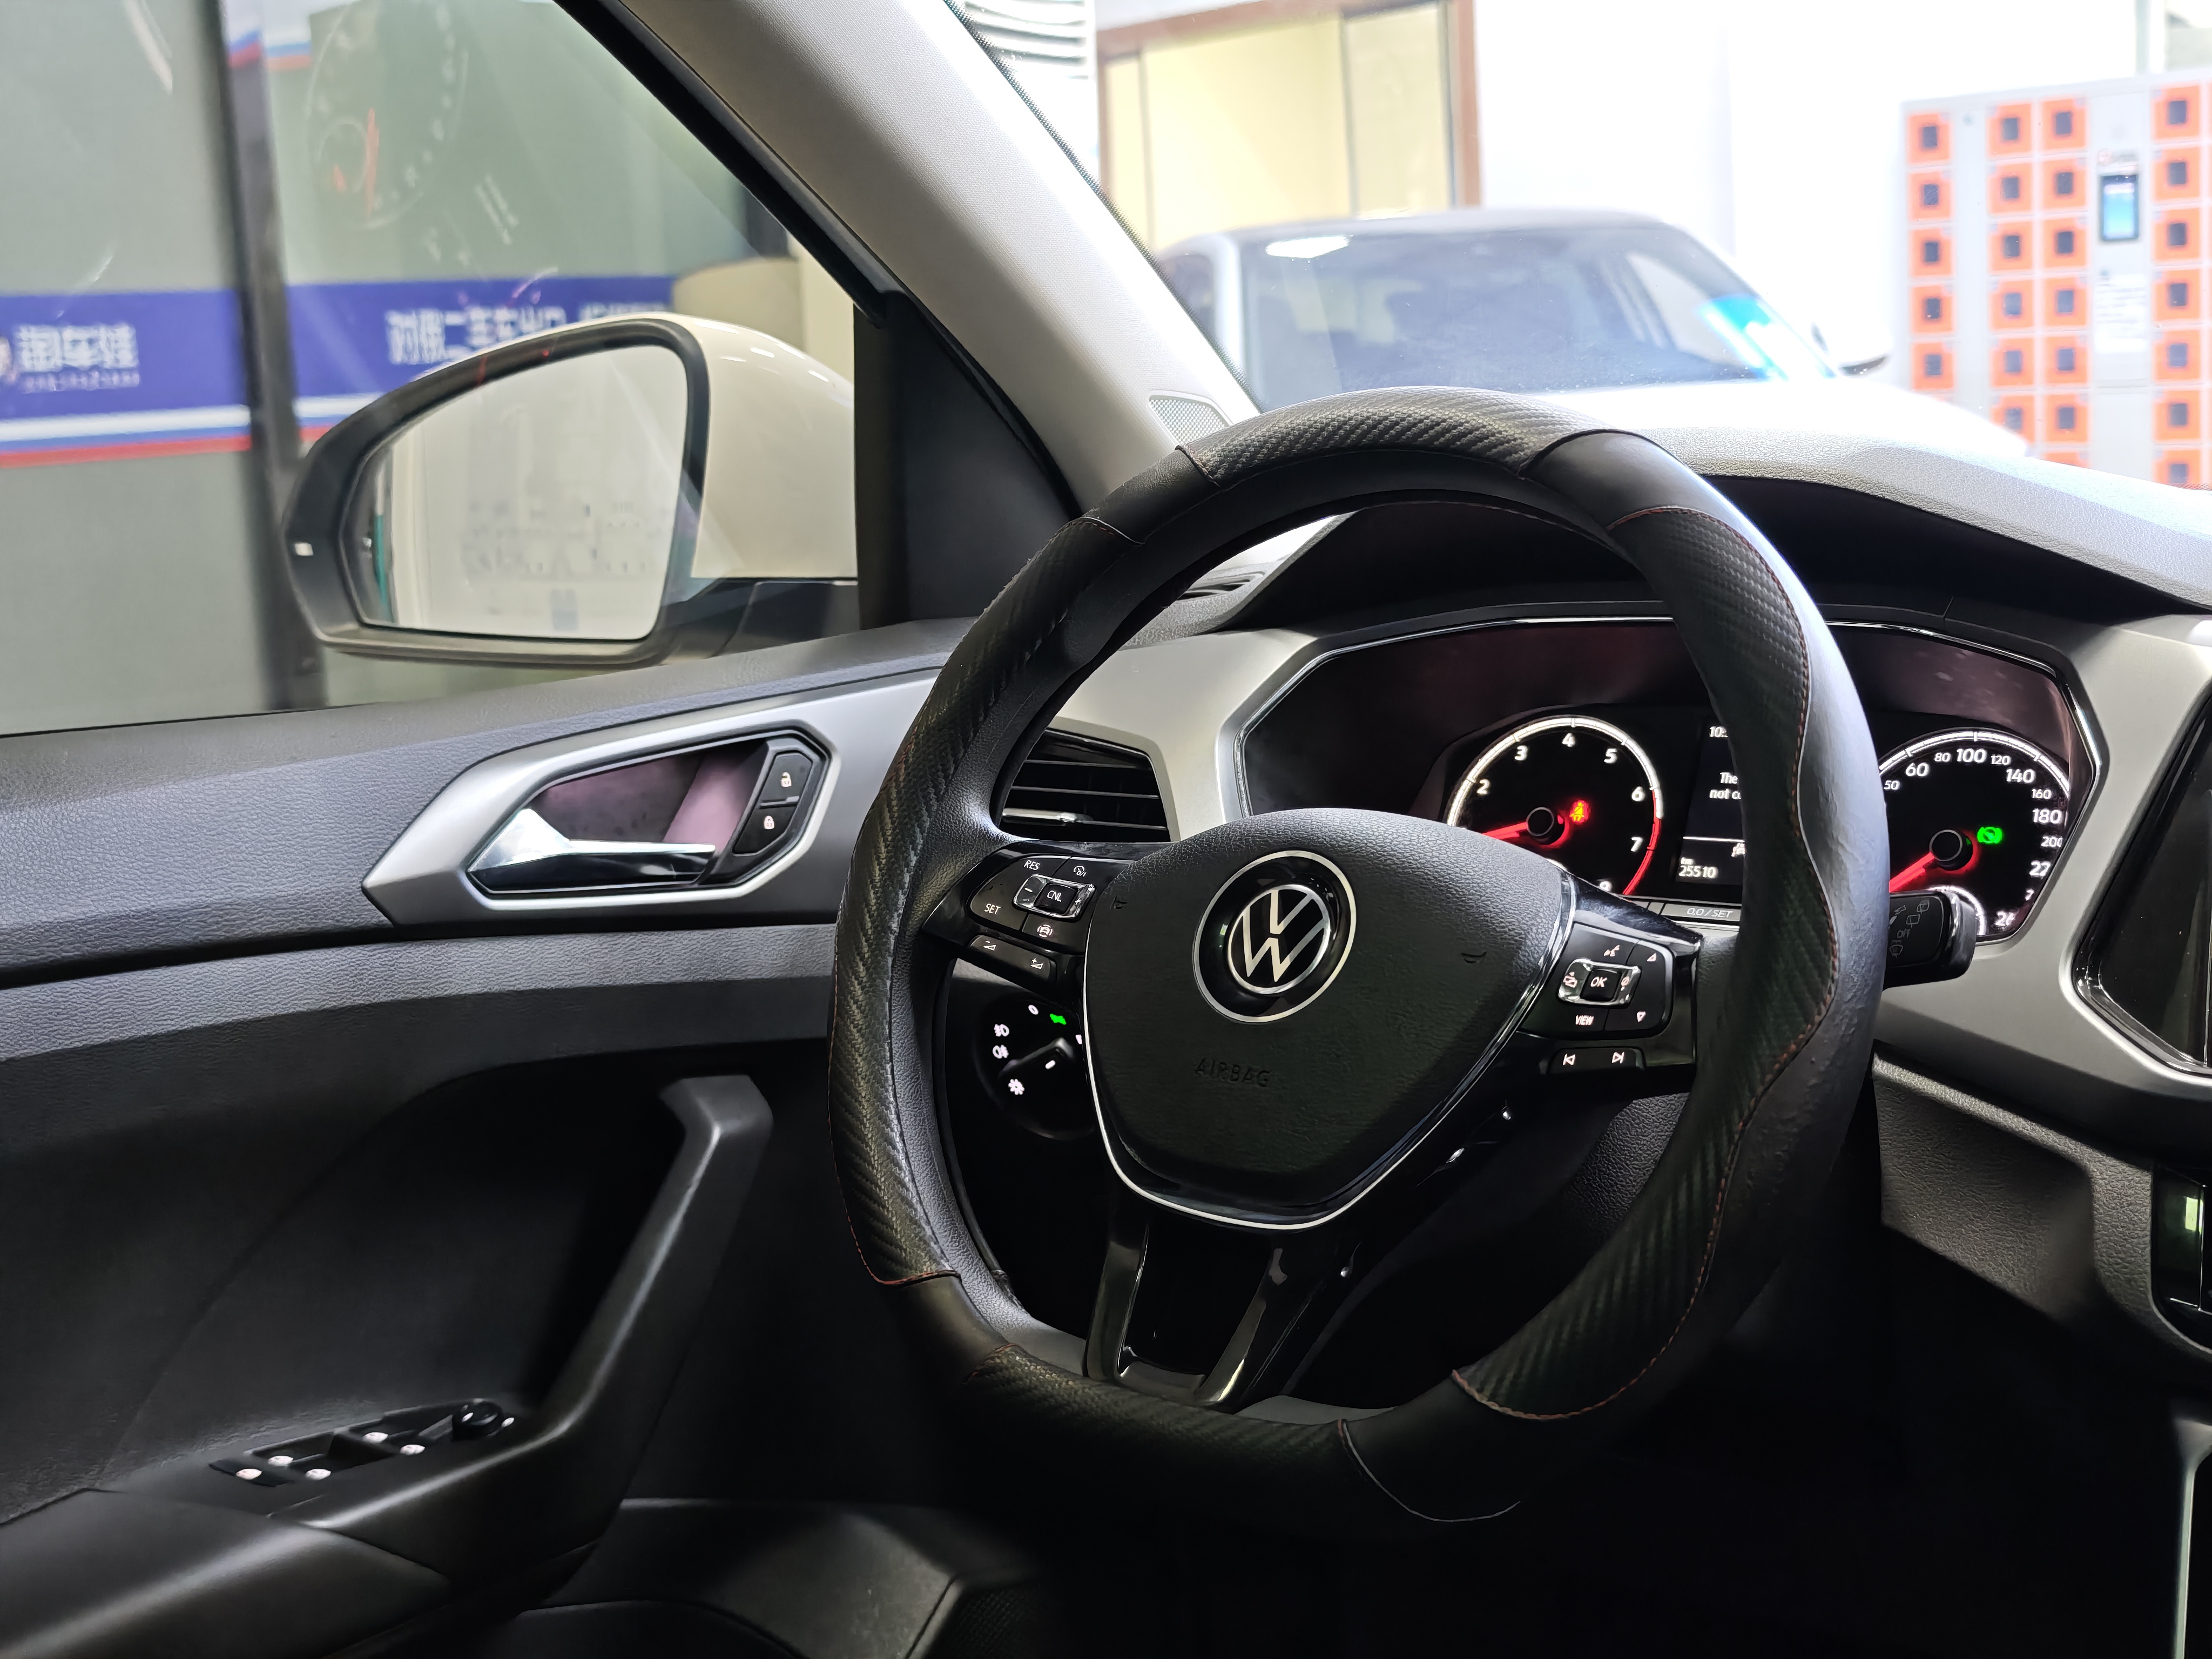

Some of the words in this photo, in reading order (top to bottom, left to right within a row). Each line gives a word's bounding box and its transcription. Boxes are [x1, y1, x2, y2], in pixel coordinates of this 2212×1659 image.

[1562, 733, 1575, 747] 4
[1515, 745, 1528, 761] 3
[1604, 748, 1617, 763] 5
[1935, 752, 1951, 763] 80
[1957, 749, 1986, 763] 100
[1991, 754, 2011, 766] 120
[1905, 763, 1928, 777] 60
[2006, 768, 2035, 783] 140
[1719, 772, 1738, 784] The
[1883, 779, 1900, 790] 50
[1478, 779, 1490, 794] 2
[1631, 786, 1644, 801] 6
[1709, 788, 1730, 799] not
[2031, 788, 2052, 799] 160
[2032, 810, 2062, 824] 180
[1630, 837, 1642, 852] 7
[1023, 859, 1041, 871] RES
[1678, 865, 1717, 879] 25510
[1046, 889, 1063, 902] CNL
[984, 903, 1001, 916] SET
[1590, 976, 1607, 988] OK
[1575, 1015, 1594, 1026] VIEW
[1195, 1056, 1272, 1088] AIRBAG
